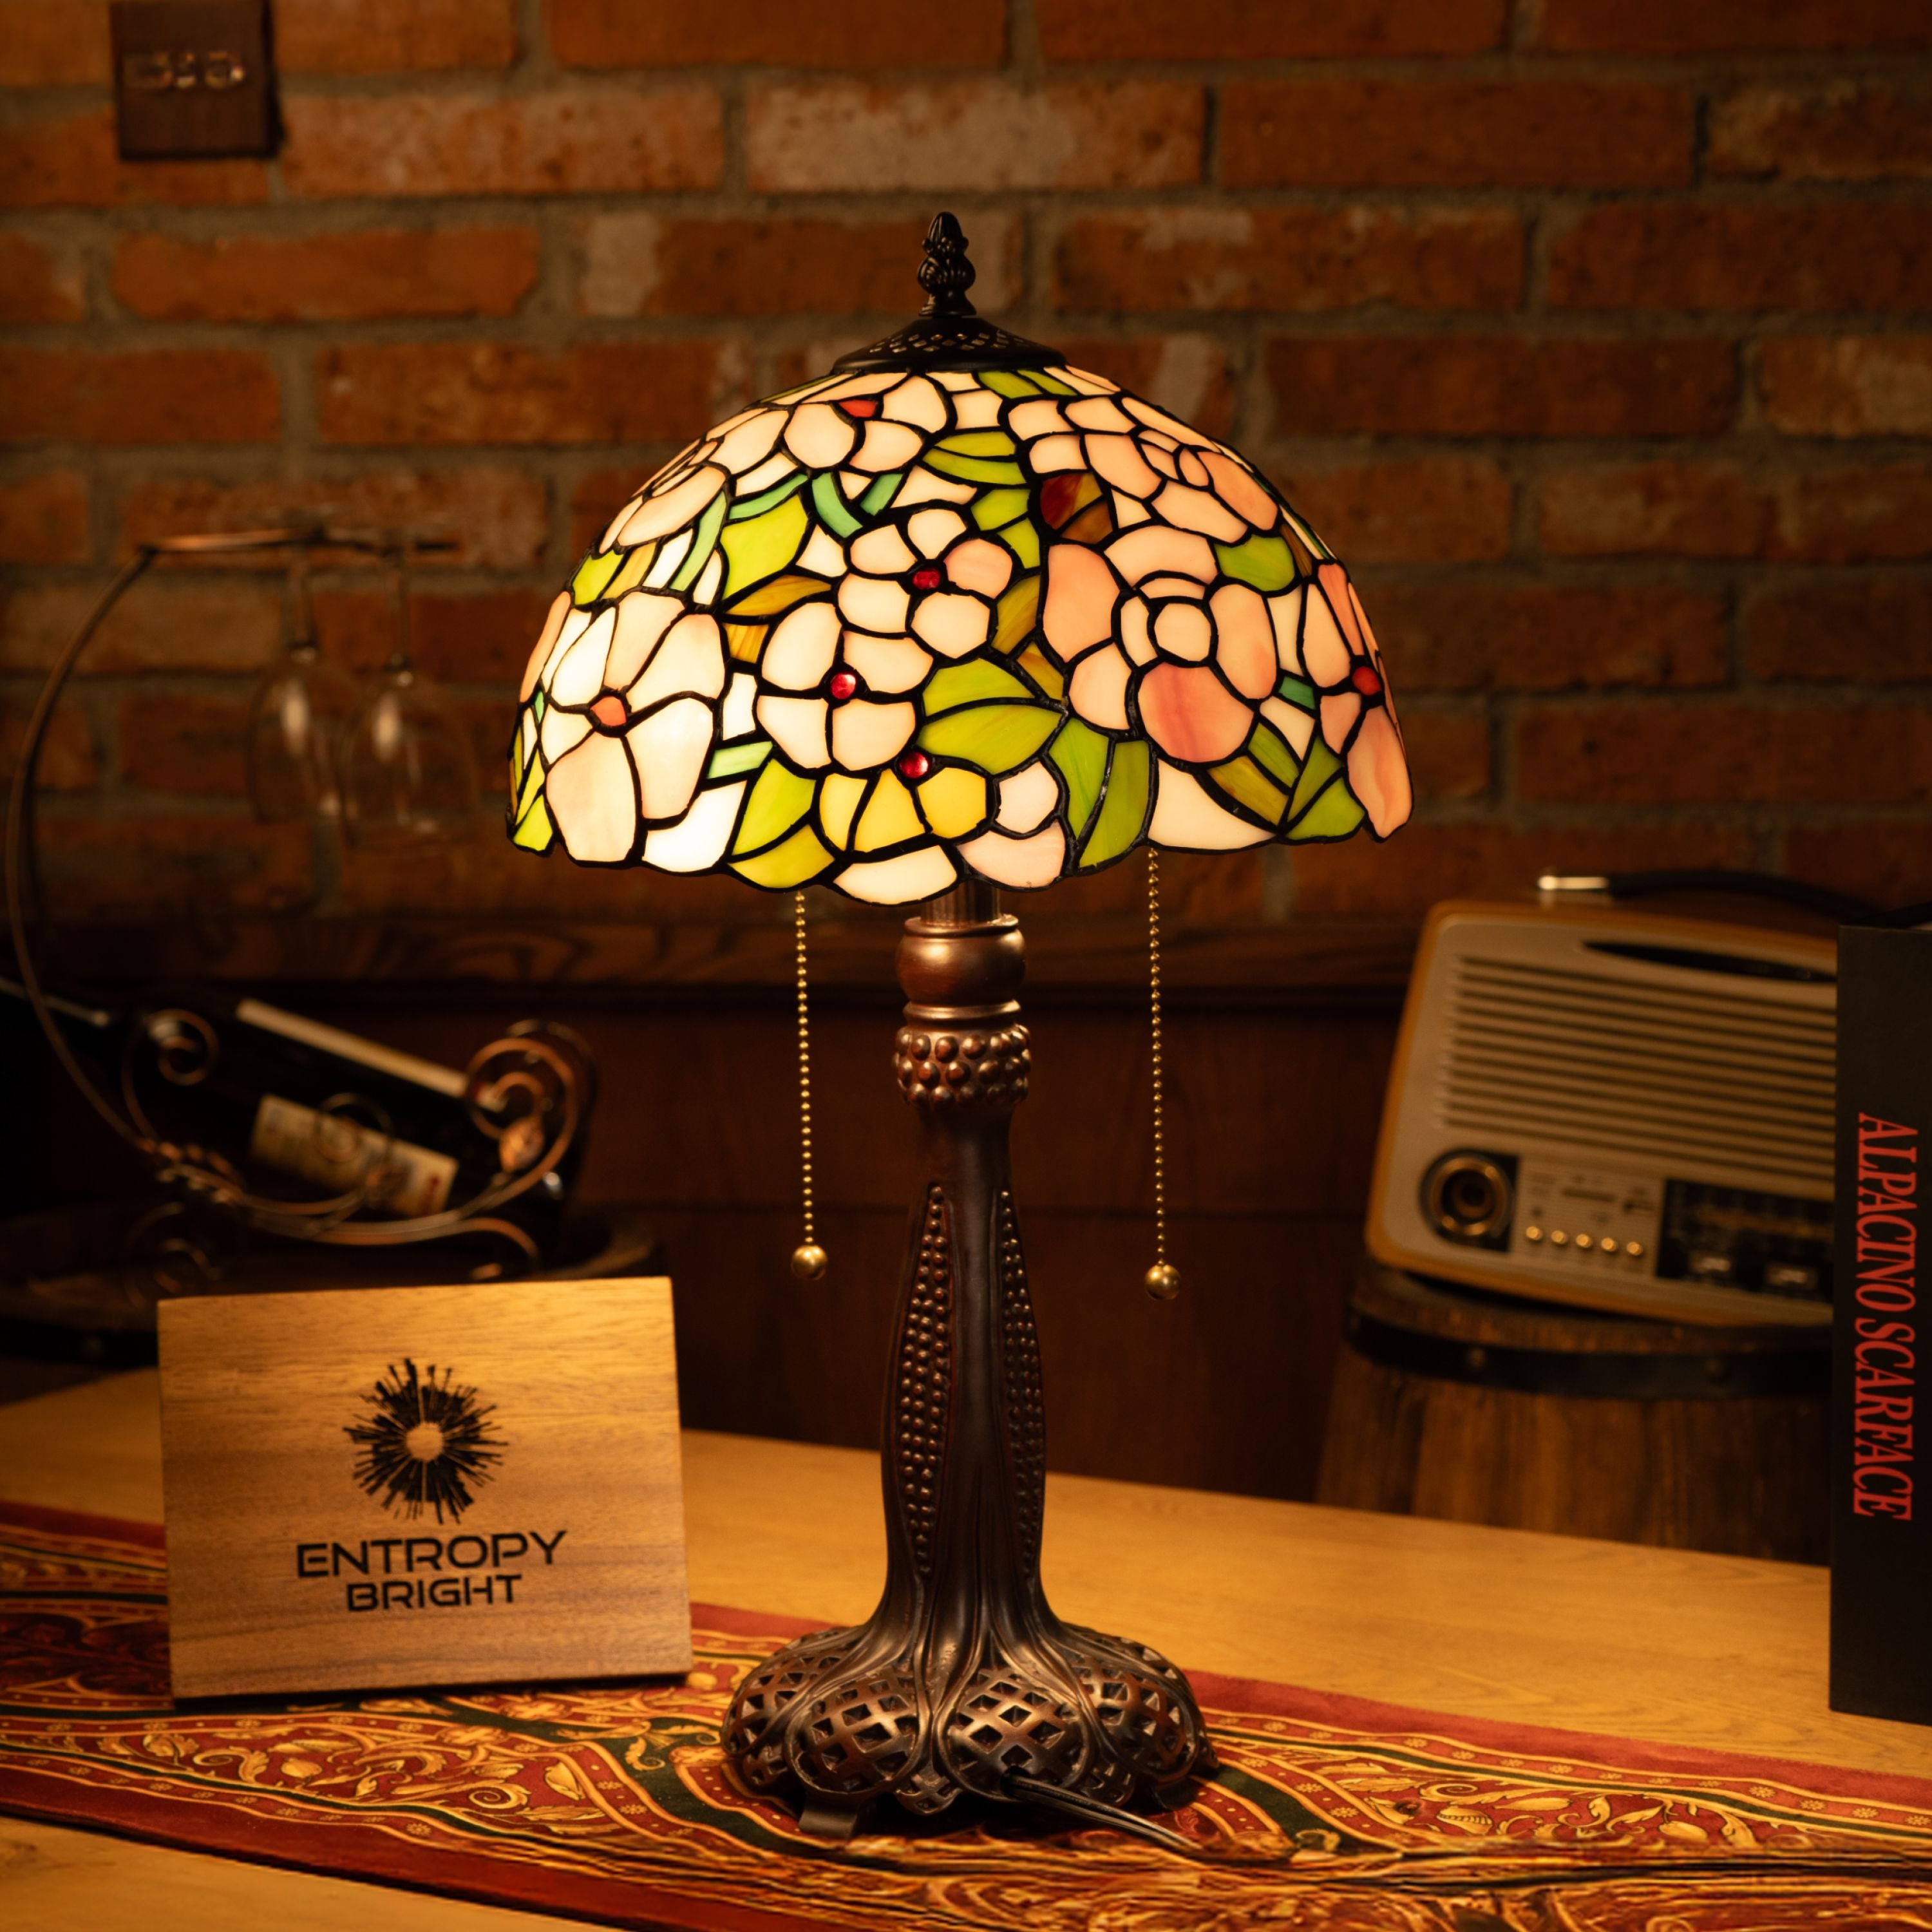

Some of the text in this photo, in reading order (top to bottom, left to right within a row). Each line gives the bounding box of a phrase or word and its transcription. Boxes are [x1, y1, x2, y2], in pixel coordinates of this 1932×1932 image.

[1853, 1318, 1915, 1520] SCARFACE
[296, 1530, 567, 1578] ENTROPY
[346, 1574, 522, 1613] BRIGHT
